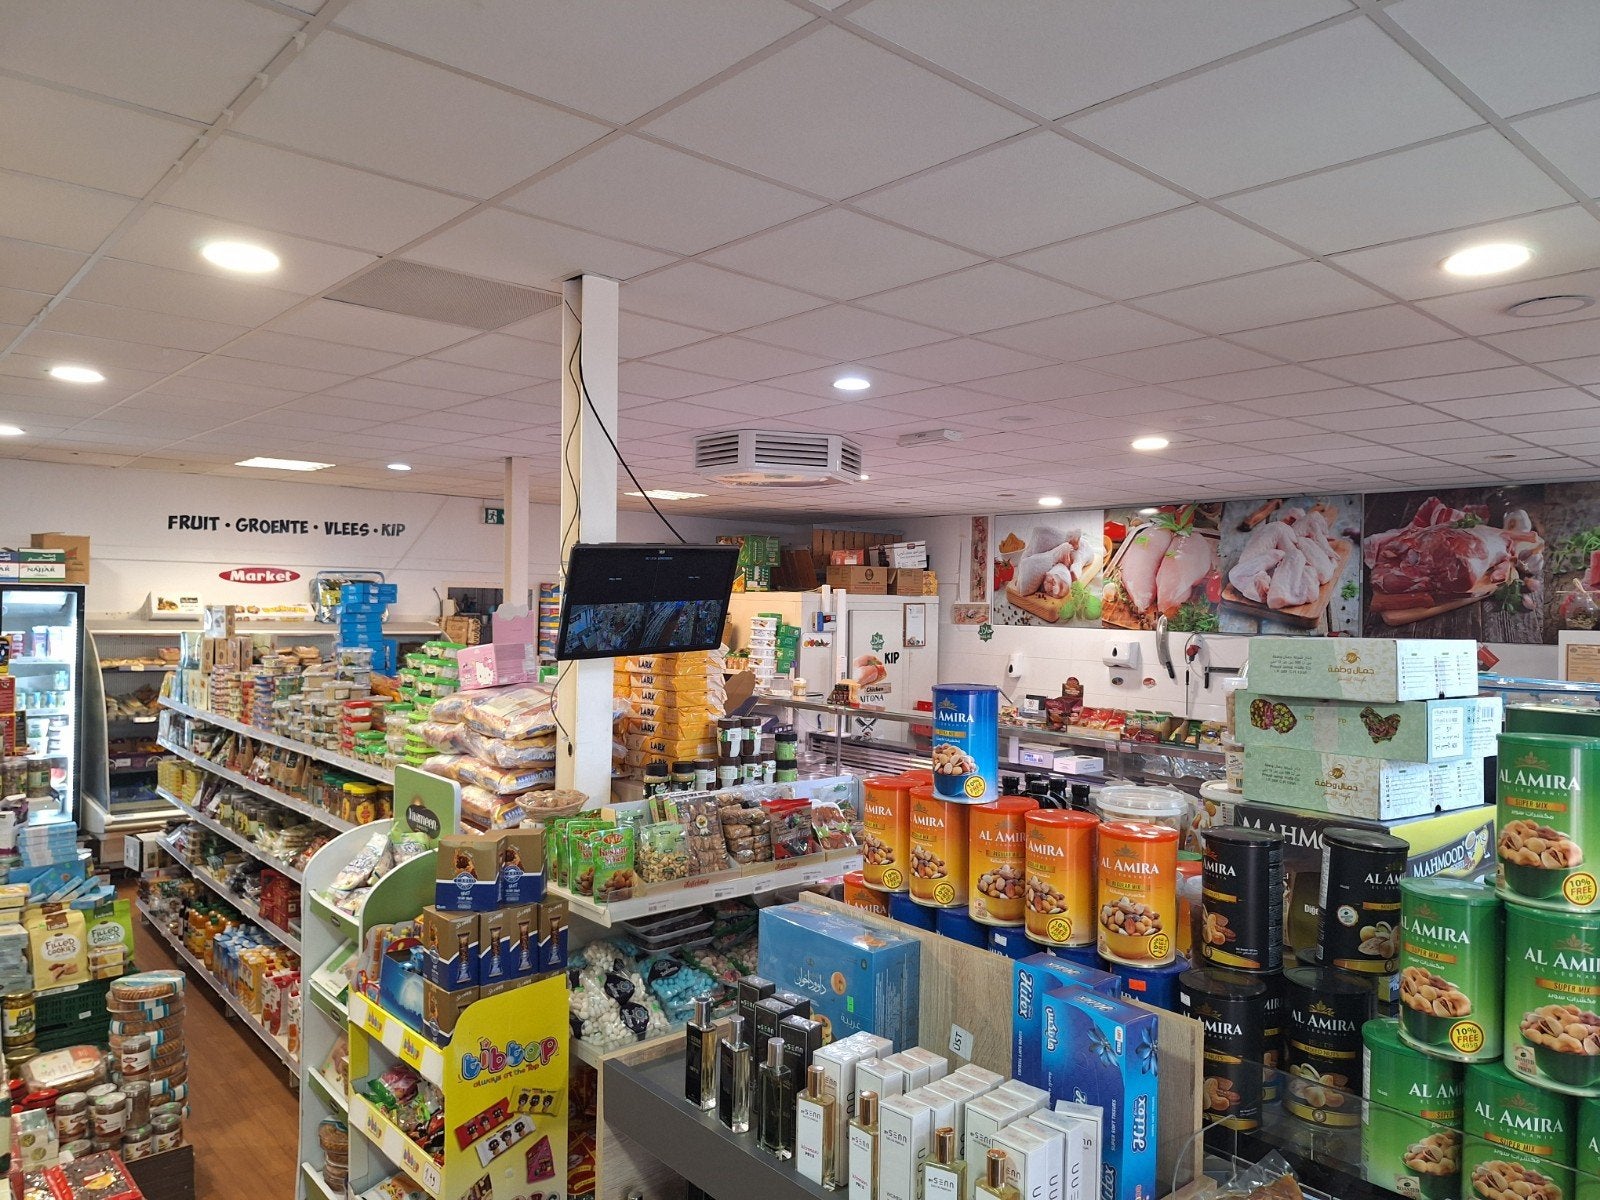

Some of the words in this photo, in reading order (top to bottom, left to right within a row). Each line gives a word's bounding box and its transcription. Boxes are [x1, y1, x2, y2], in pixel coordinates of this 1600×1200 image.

[168, 515, 220, 531] FRUIT
[236, 518, 309, 534] GROENTE
[324, 522, 370, 536] VLEES
[381, 524, 406, 536] KIP
[229, 570, 292, 583] Market
[638, 660, 655, 669] LARK
[884, 652, 900, 664] KIP
[641, 676, 656, 684] LARK
[641, 691, 657, 701] LARK
[640, 706, 656, 717] LARK
[939, 711, 974, 722] AMIRA
[640, 722, 656, 732] LARK
[650, 742, 666, 751] LARK
[1499, 769, 1511, 783] AL
[1515, 770, 1580, 791] AMIRA
[865, 803, 893, 816] AMIRA
[1515, 798, 1535, 808] SUPER
[1536, 801, 1548, 809] MIX
[913, 815, 944, 828] AMIRA
[979, 830, 992, 841] AL
[996, 830, 1026, 843] AMIR
[1028, 840, 1064, 857] AMIRA
[1101, 857, 1111, 869] AL
[1114, 859, 1160, 874] AMIRA
[1413, 845, 1464, 877] MAHMOOD
[1204, 861, 1236, 877] AMIRA
[1365, 874, 1383, 884] AL
[1570, 878, 1591, 887] 10%
[1571, 885, 1592, 895] FREE
[1412, 919, 1470, 944] AMIRA
[1524, 947, 1547, 965] AL
[1018, 970, 1034, 1019] Hitex
[1554, 982, 1576, 993] SUPER
[1578, 985, 1591, 994] MIX
[1197, 1016, 1242, 1035] MIRA
[1292, 1009, 1305, 1024] AL
[1307, 1014, 1356, 1031] AMIRA
[1456, 1027, 1477, 1036] 10%
[1457, 1034, 1479, 1044] FREE
[1409, 1083, 1432, 1098] AL
[1133, 1096, 1147, 1150] Hitex
[1475, 1101, 1495, 1121] AL
[1499, 1109, 1563, 1132] AMIRA
[1500, 1138, 1521, 1150] SUPER
[1523, 1144, 1535, 1153] MIX
